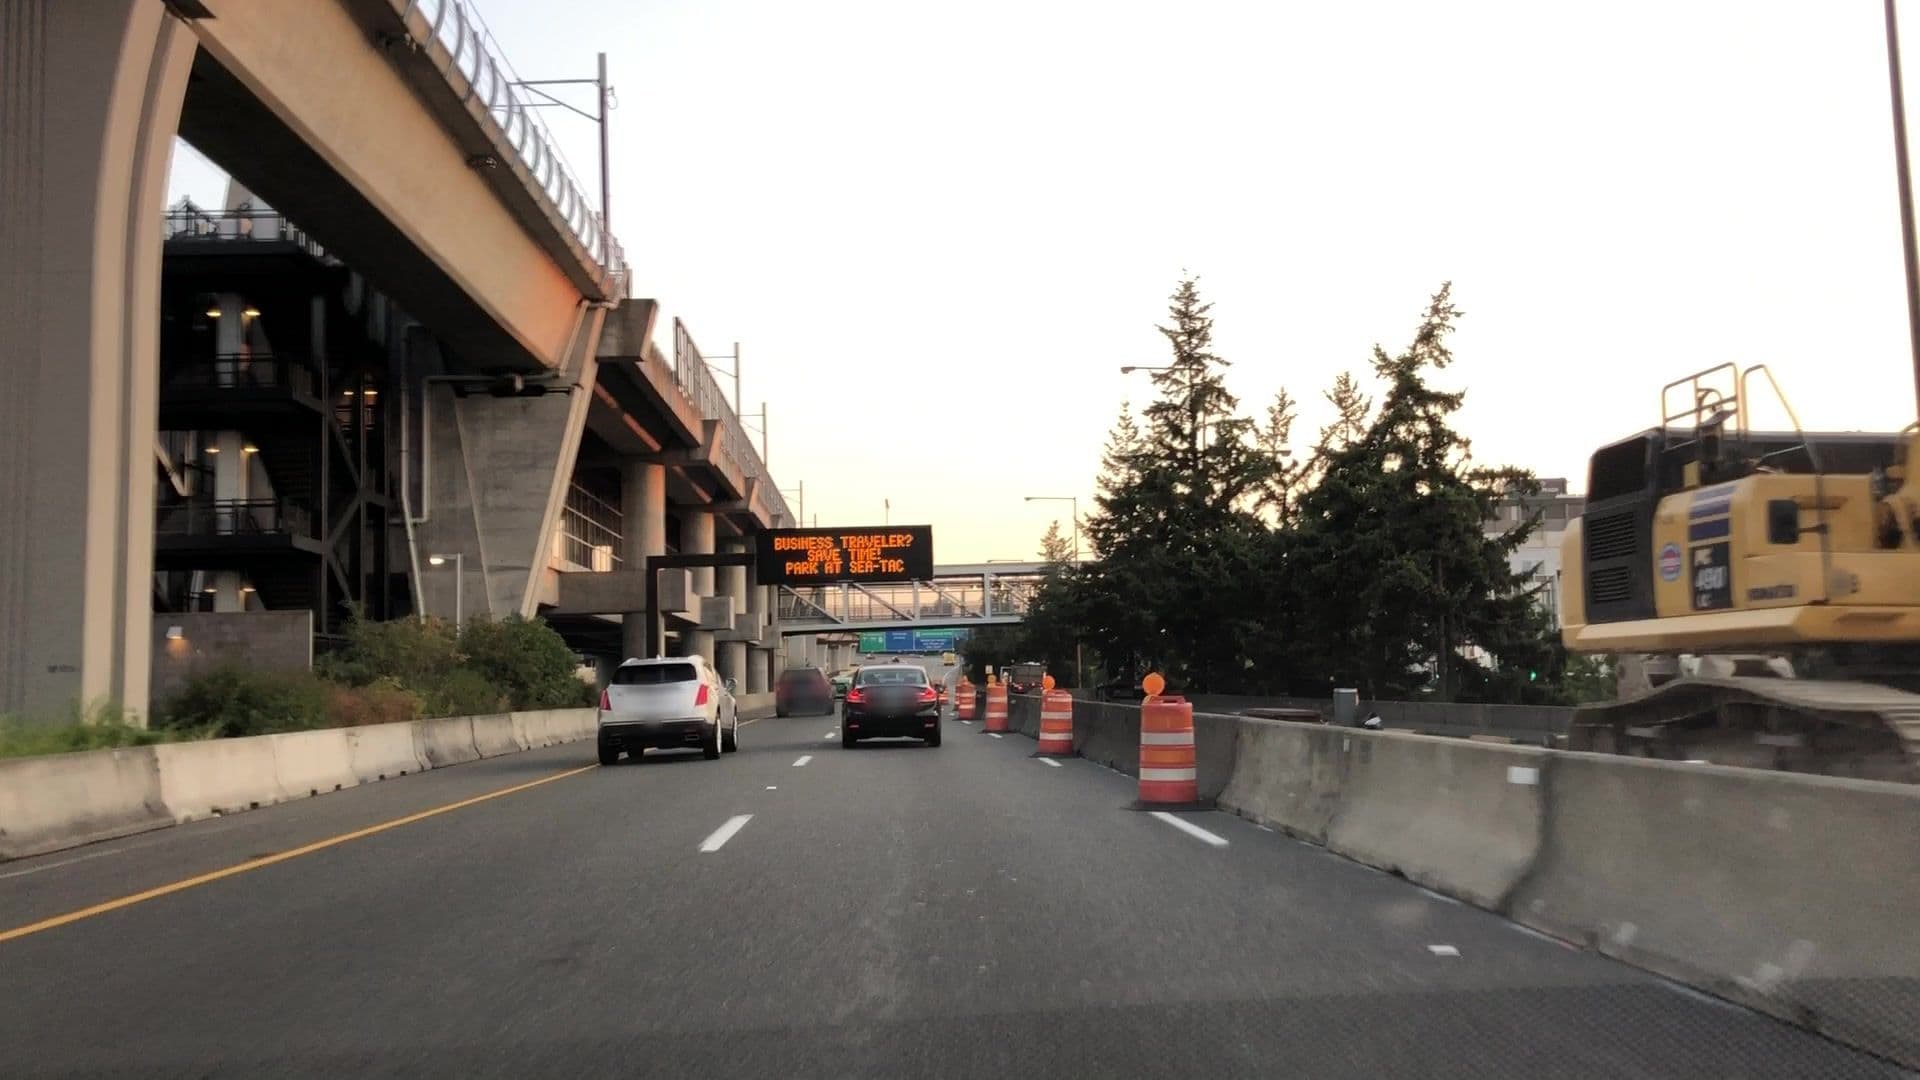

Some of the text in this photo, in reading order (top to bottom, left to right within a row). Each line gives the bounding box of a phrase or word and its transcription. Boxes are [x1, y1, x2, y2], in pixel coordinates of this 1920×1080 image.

[774, 534, 913, 550] BUSINESS TRAVELER?
[807, 548, 882, 562] SAVE TIME!
[785, 560, 905, 575] PARK AT SEA-TAC
